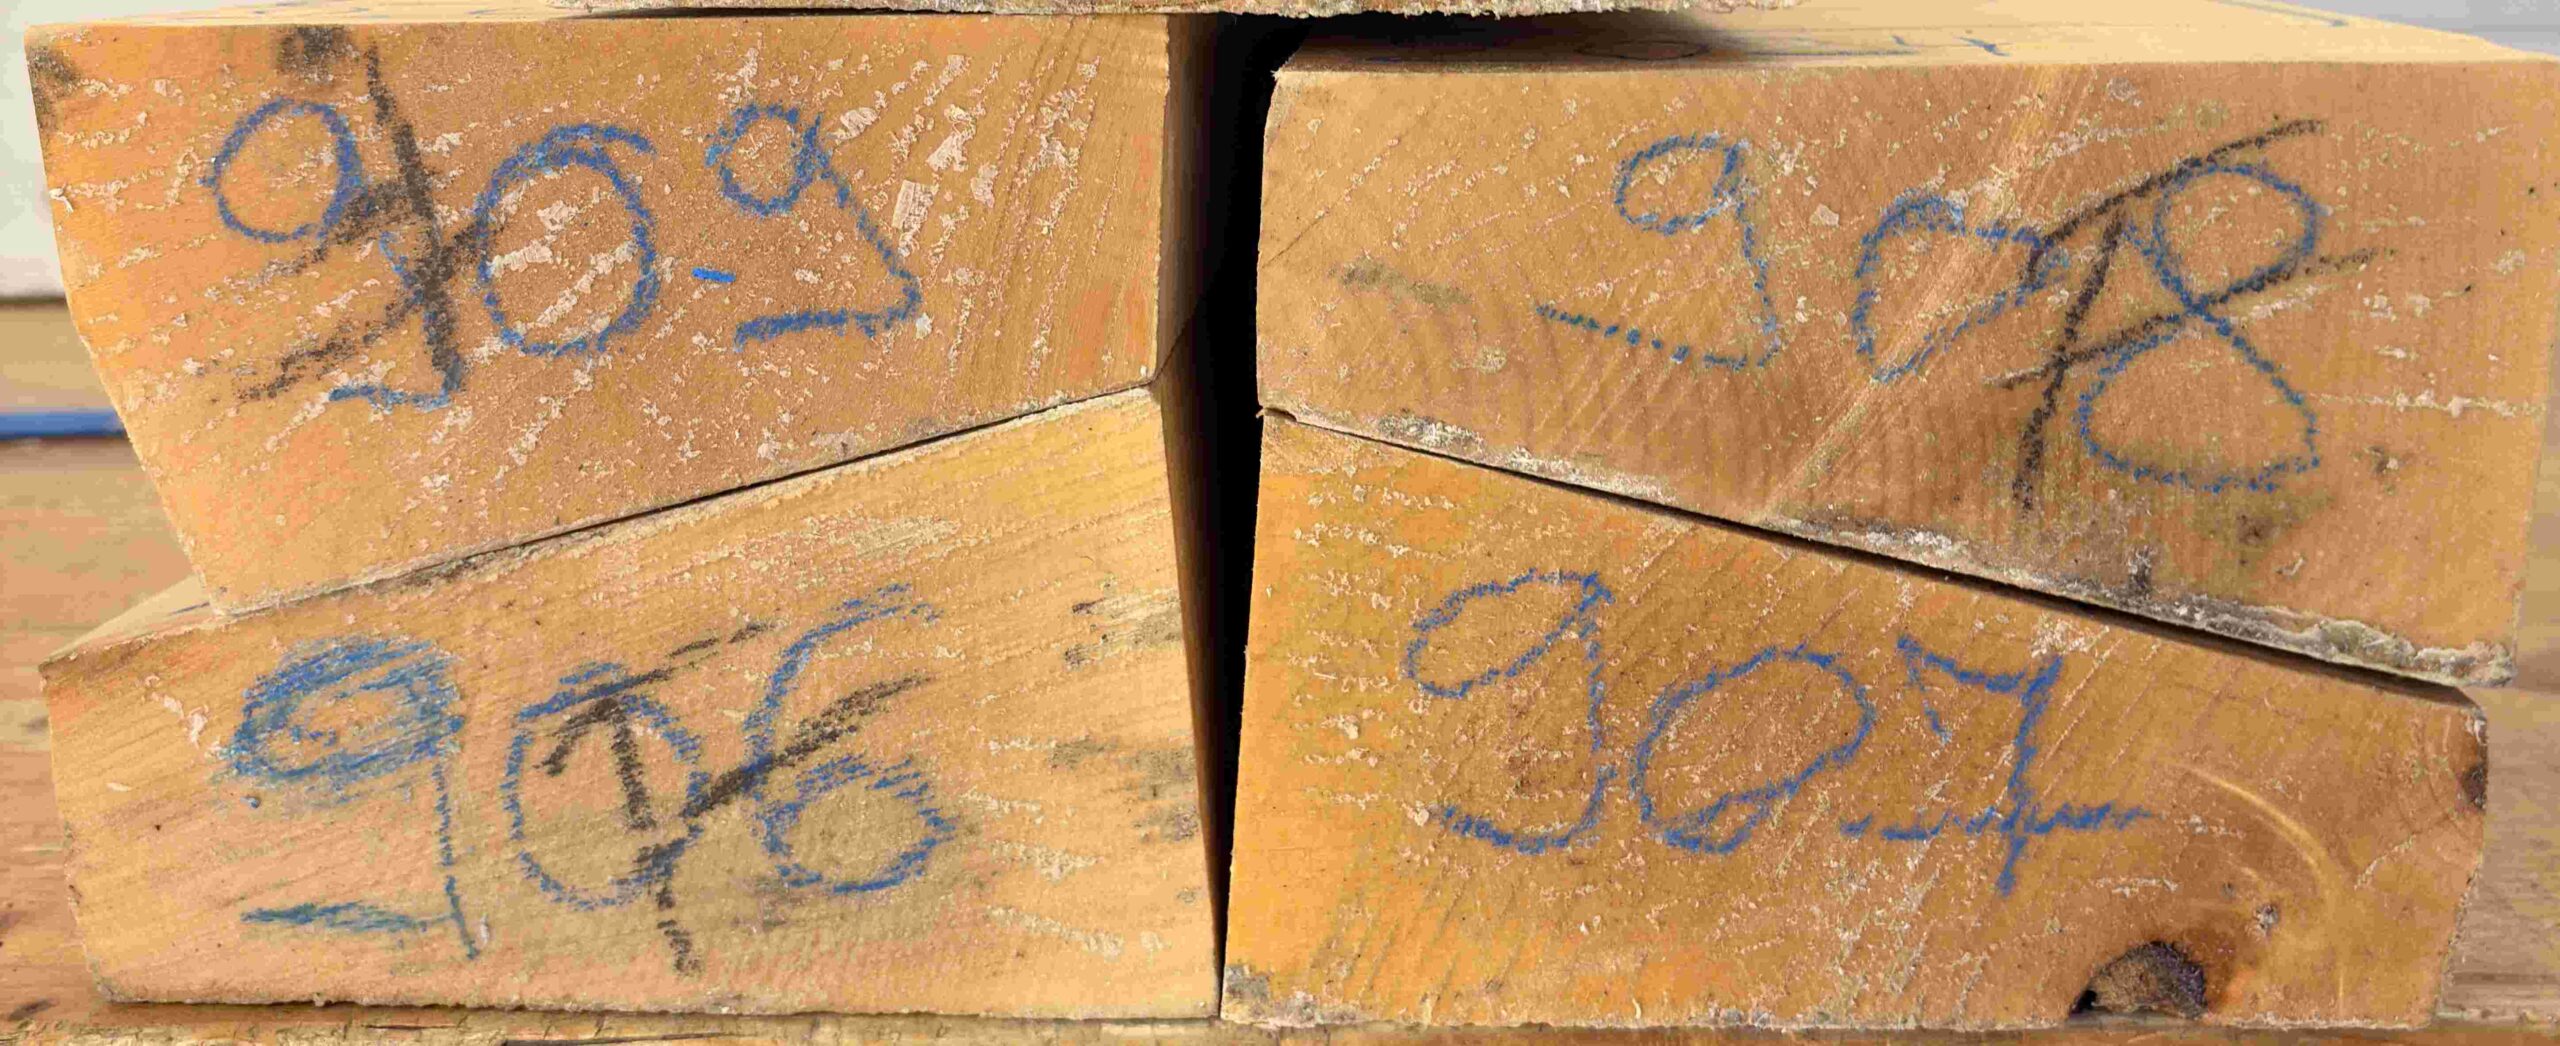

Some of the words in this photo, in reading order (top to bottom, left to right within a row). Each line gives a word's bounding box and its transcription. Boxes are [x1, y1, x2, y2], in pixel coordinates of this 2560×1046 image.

[1536, 128, 2321, 492] 908
[226, 582, 956, 960] 906
[1404, 568, 2152, 896] 907
